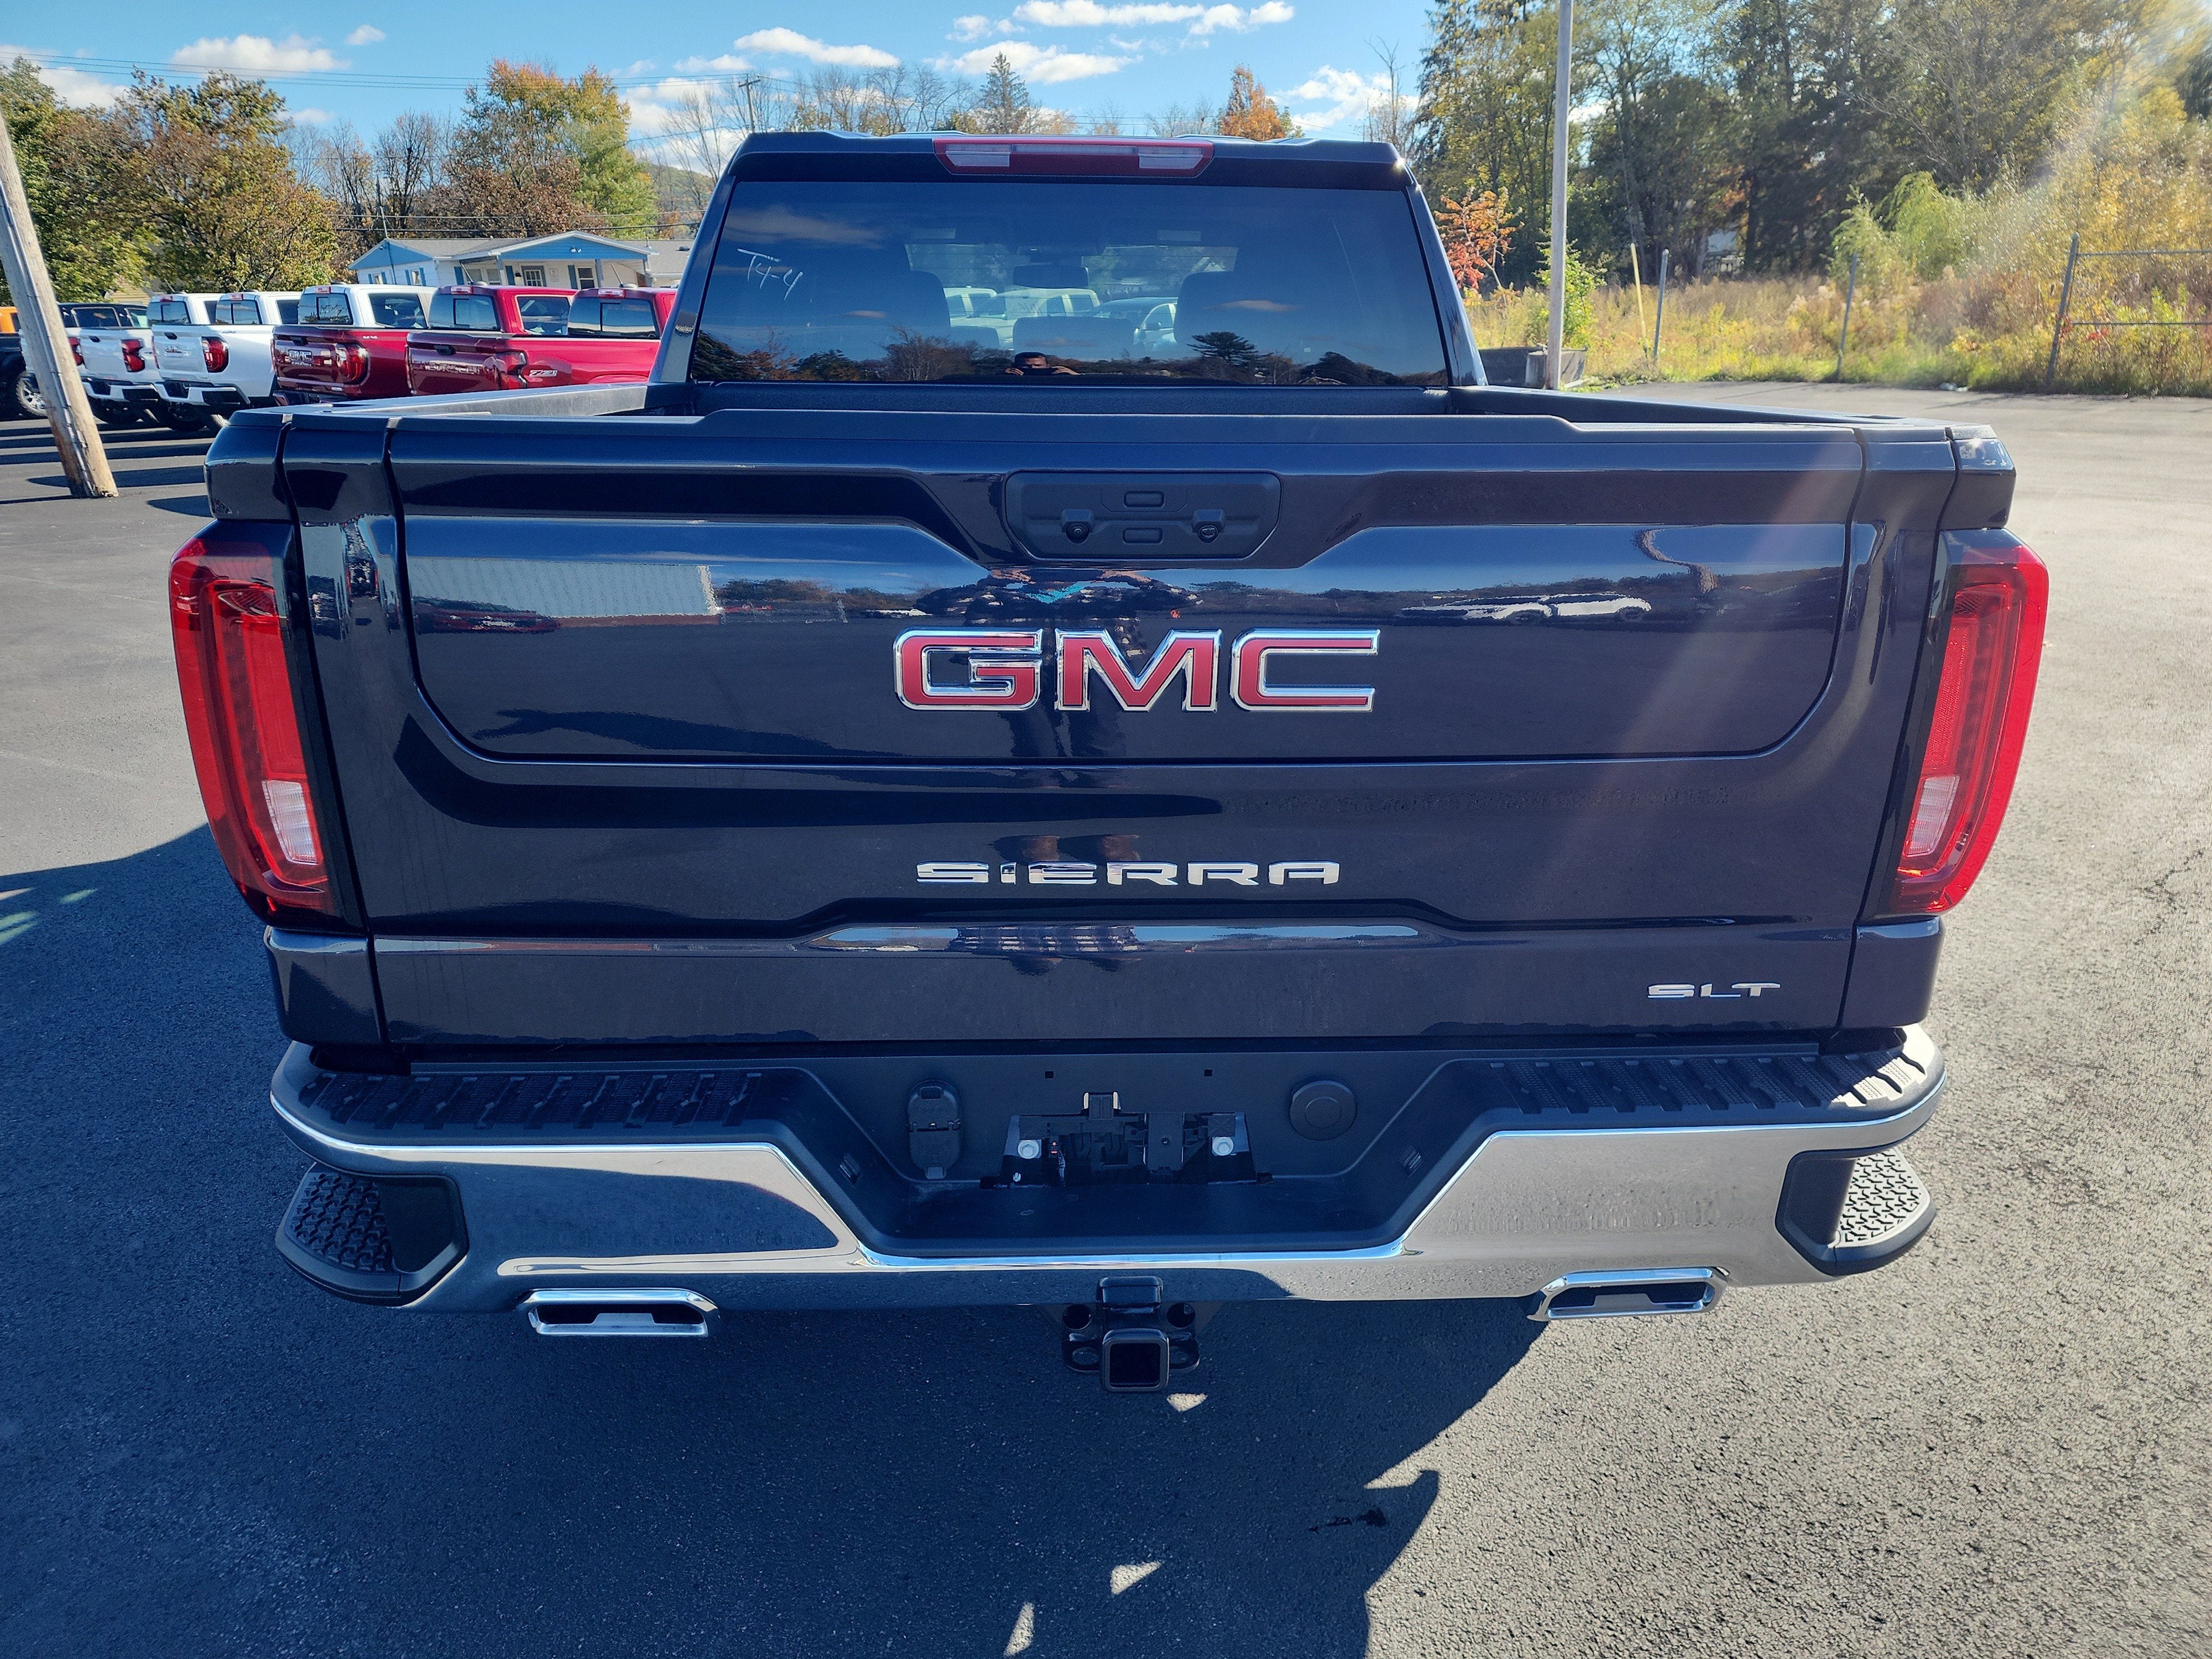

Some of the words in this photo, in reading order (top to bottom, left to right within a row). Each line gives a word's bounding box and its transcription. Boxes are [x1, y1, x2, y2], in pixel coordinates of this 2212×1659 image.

[893, 628, 1381, 712] GMC
[916, 862, 1340, 885] SIERRA
[1647, 982, 1781, 998] SLT
